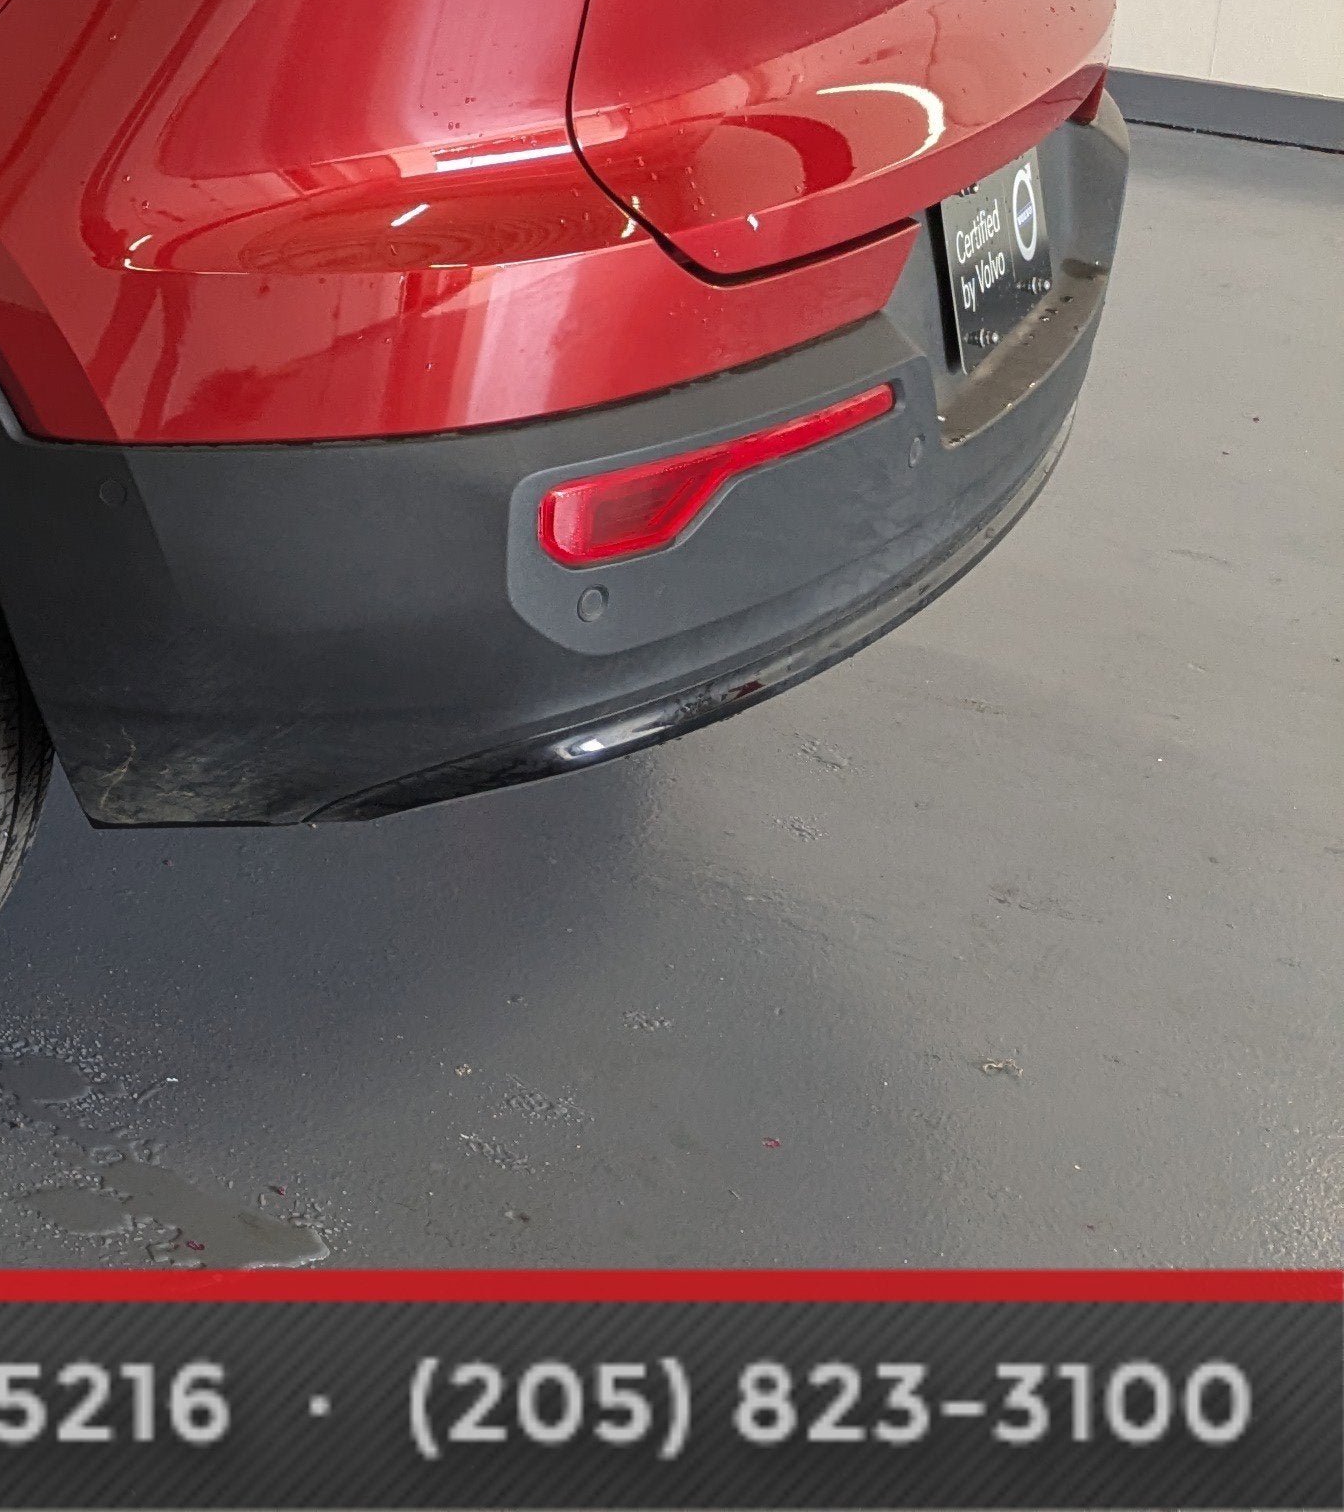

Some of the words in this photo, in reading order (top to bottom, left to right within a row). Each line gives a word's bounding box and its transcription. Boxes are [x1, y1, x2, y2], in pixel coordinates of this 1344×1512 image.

[956, 198, 1001, 265] Certified
[961, 276, 976, 313] by
[975, 251, 1006, 294] Volvo
